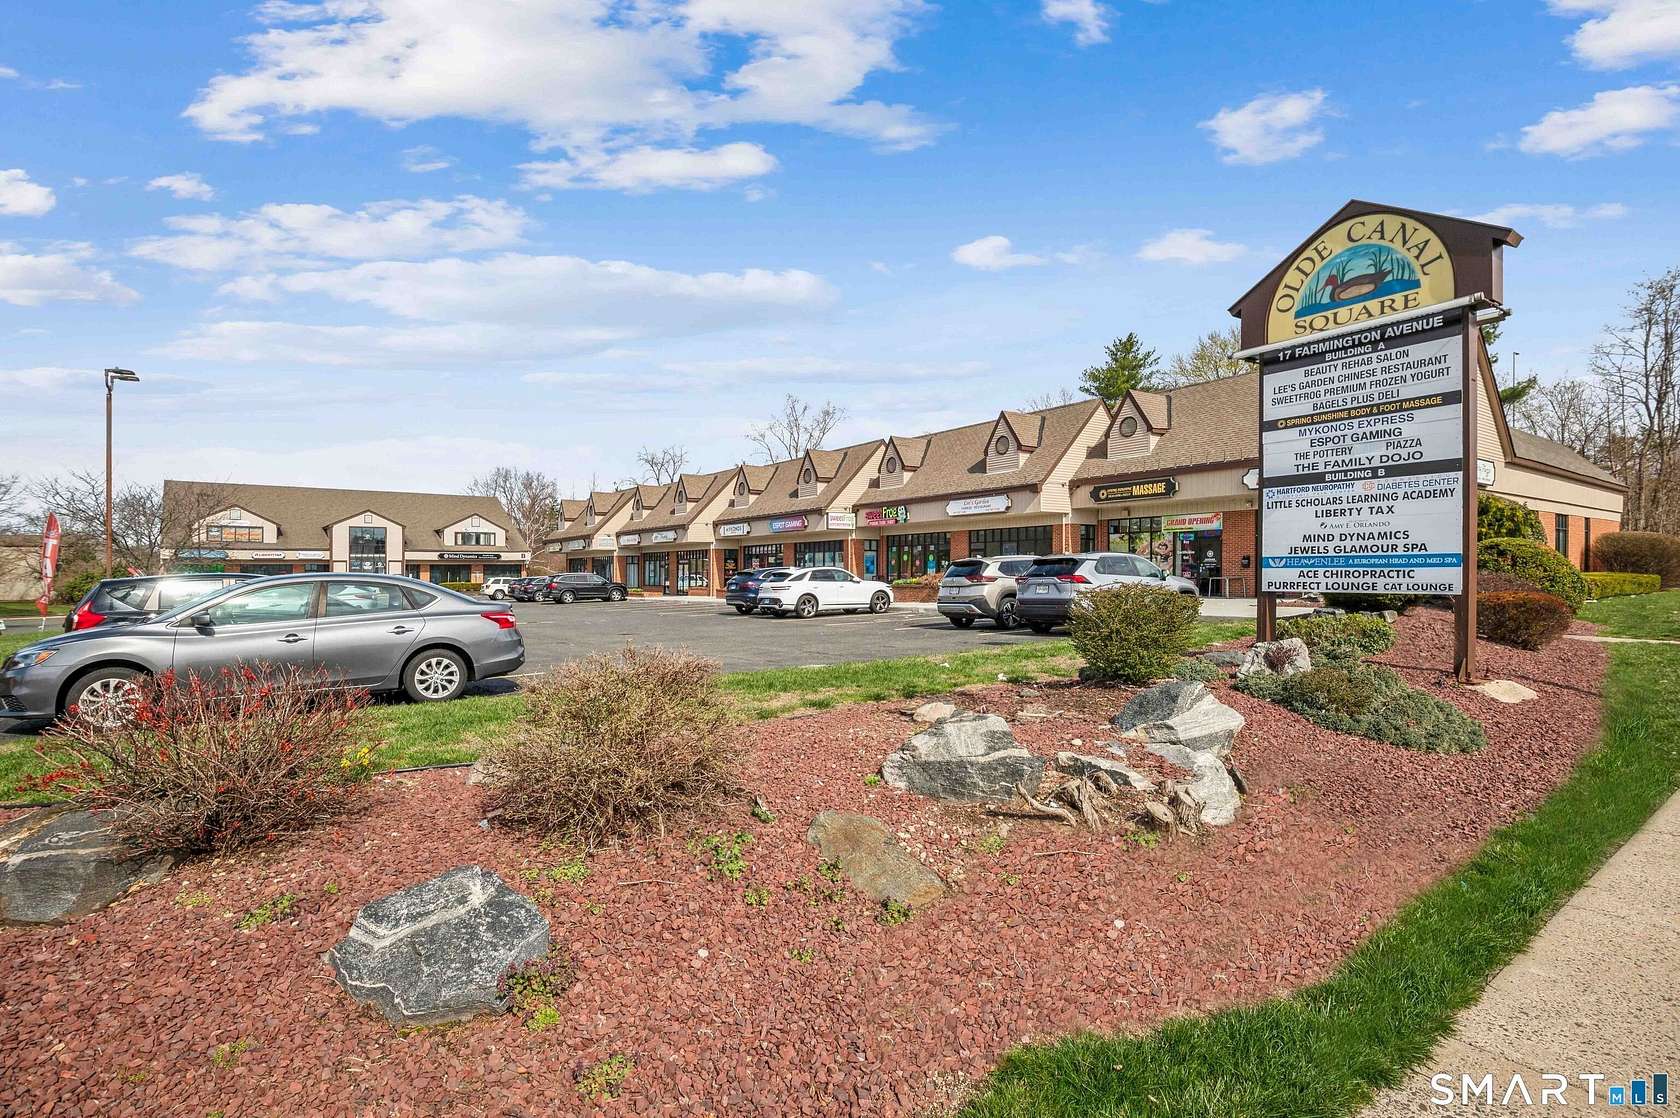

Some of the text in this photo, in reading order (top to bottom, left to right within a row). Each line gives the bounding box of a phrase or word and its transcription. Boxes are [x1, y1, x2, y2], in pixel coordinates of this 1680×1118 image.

[1276, 220, 1444, 313] OLDE CANAL
[1294, 290, 1421, 334] SQUARE
[1278, 316, 1444, 361] 17 FARMINGTON AVENUE
[1304, 349, 1410, 377] BEAUTY REHAB SALON
[1325, 345, 1372, 361] BUILDING
[1273, 355, 1449, 394] LEE'S GARDEN CHINESE RESTAURANT
[1271, 367, 1451, 406] SWEETFROG PREMIUM FROZEN YOGURT
[1313, 390, 1400, 411] BAGELS PLUS DELI
[1286, 416, 1311, 426] SPRING
[1313, 410, 1349, 421] SUNSHINE
[1350, 407, 1371, 416] BODY
[1379, 403, 1400, 411] FOOT
[1402, 397, 1442, 408] MASSAGE
[1299, 413, 1414, 437] MYKONOS EXPRESS
[1310, 428, 1402, 447] ESPOT GAMING
[1294, 438, 1422, 461] THE POTTERY PIAZZA
[1294, 451, 1423, 472] THE FAMILY DOJO
[1325, 470, 1371, 481] BUILDING
[1377, 481, 1419, 490] DIABETES
[1423, 477, 1459, 487] CENTER
[1133, 483, 1166, 495] MASSAGE
[1266, 500, 1292, 509] LITTLE
[1295, 496, 1343, 507] SCHOLARS
[1347, 492, 1398, 504] LEARNING
[1402, 488, 1456, 500] ACADEMY
[1277, 485, 1309, 495] HARTFORD
[1311, 483, 1355, 492] NEUROPATHY
[1315, 505, 1395, 518] LIBERTY TAX
[1302, 531, 1410, 543] MIND DYNAMICS
[1288, 543, 1428, 554] JEWELS GLAMOUR SPA
[1298, 569, 1415, 579] ACE CHIROPRACTIC
[1267, 581, 1453, 591] PURRFECT LOUNGE CAT LOUNGE
